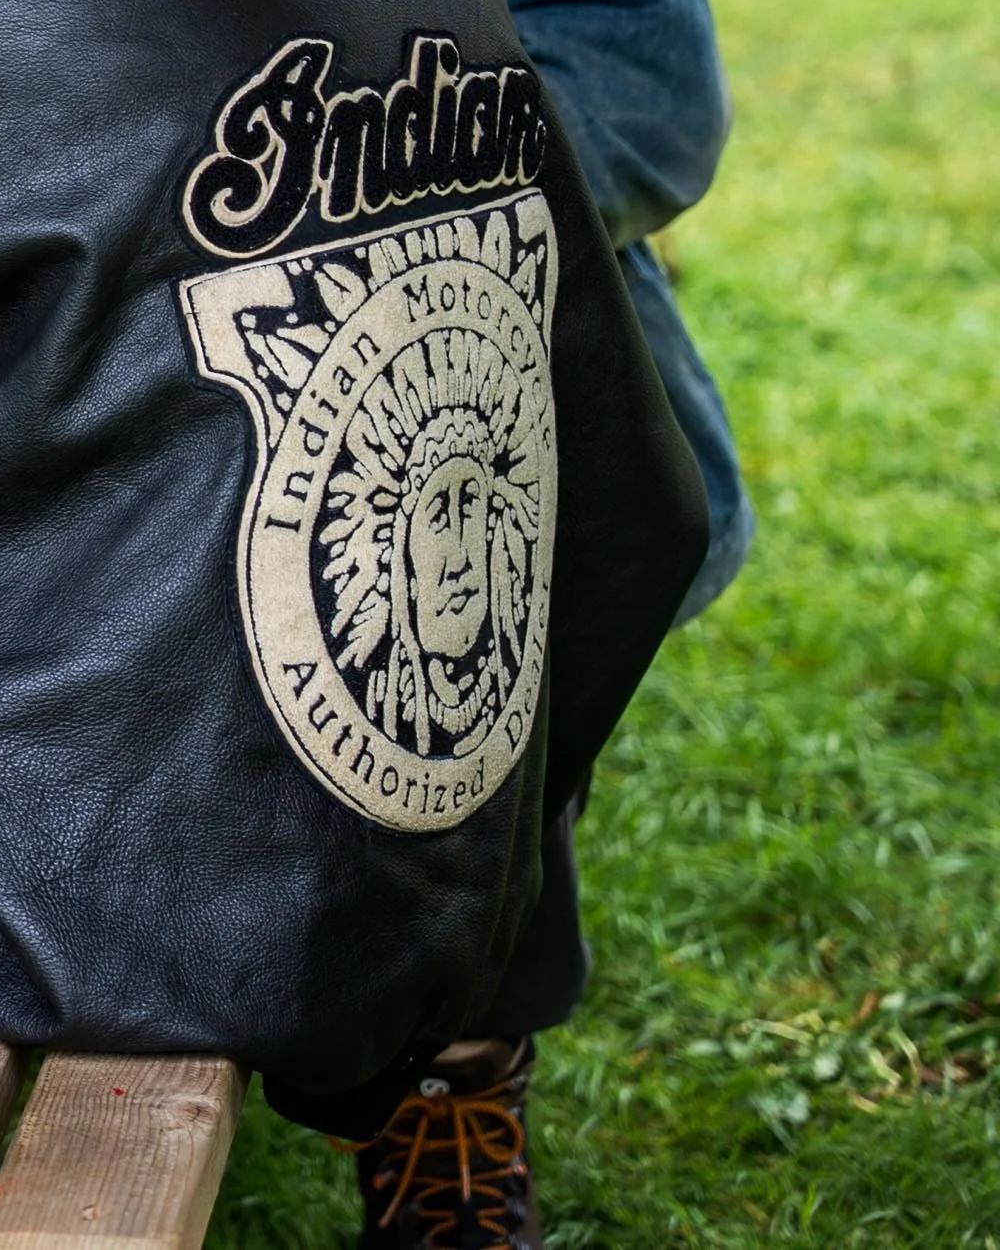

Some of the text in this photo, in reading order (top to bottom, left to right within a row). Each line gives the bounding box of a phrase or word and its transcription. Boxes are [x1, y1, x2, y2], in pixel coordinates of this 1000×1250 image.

[183, 37, 547, 258] Indian
[265, 332, 382, 533] Indian
[283, 659, 485, 814] Authorized
